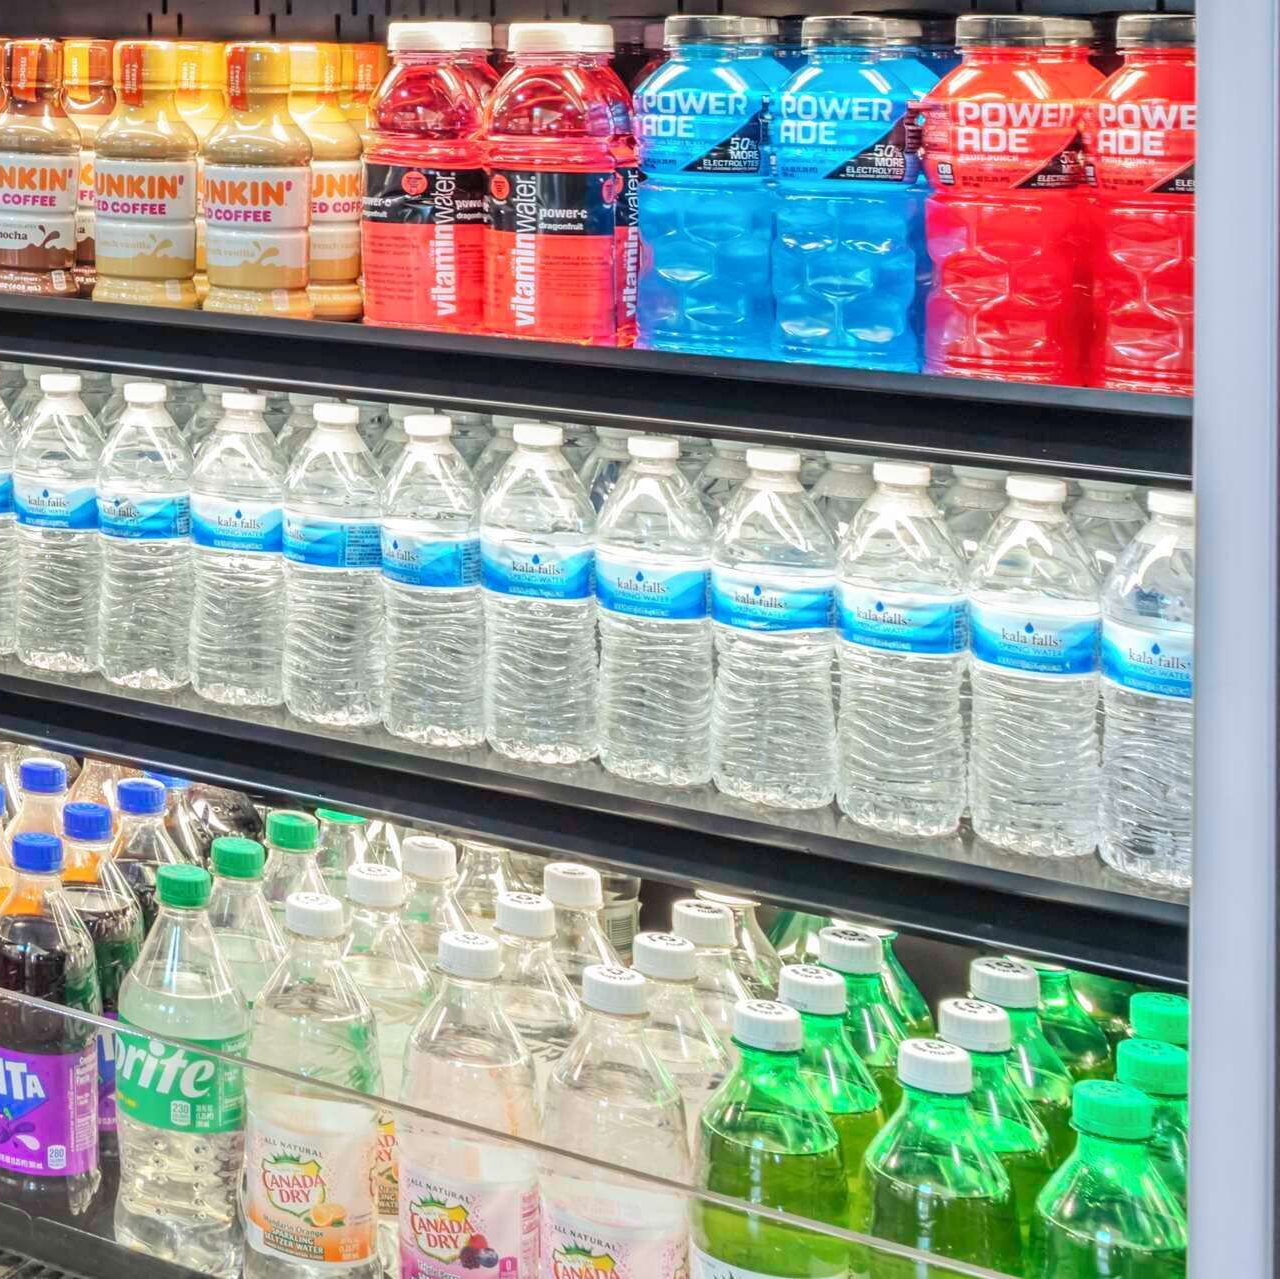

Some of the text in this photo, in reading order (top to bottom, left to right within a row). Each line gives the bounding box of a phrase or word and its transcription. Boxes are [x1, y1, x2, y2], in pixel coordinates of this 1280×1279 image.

[642, 91, 747, 116] POWER
[779, 94, 892, 121] POWER
[957, 101, 1074, 128] POWER
[1098, 102, 1196, 131] POWE
[642, 115, 696, 138] ADE
[779, 121, 837, 145] ADE
[957, 127, 1031, 153] ADE
[1097, 129, 1165, 156] ADE
[730, 150, 760, 160] MORE
[873, 144, 904, 159] 50%
[702, 159, 760, 169] ELECTROLYTES
[874, 157, 905, 168] MORE
[845, 167, 905, 176] ELECTROLYTES
[95, 171, 184, 200] UNKIN'
[204, 176, 293, 207] UNKIN'
[2, 193, 57, 207] COFFEE
[110, 200, 167, 216] COFFEE
[215, 208, 272, 224] COFFEE
[539, 207, 588, 220] power-c
[539, 221, 584, 233] dragonfruit
[429, 170, 458, 317] vitaminwater.
[506, 173, 538, 327] vitaminwater.
[217, 515, 262, 530] kala falls
[511, 560, 563, 576] kala falls
[617, 576, 668, 594] kala falls
[734, 593, 786, 610] kala falls
[856, 607, 910, 627] kala falls
[1001, 627, 1061, 648] kala falls
[1034, 645, 1063, 657] WATER
[1128, 647, 1189, 670] kala falls
[116, 1024, 216, 1099] rite
[172, 1103, 190, 1114] 230
[49, 1148, 65, 1159] 280
[281, 1141, 323, 1158] NATURAL
[262, 1169, 327, 1193] CANADA
[279, 1187, 313, 1204] DRY
[410, 1178, 472, 1204] ALL NATURAL
[295, 1223, 325, 1238] Orange
[410, 1212, 476, 1235] CANADA
[296, 1242, 325, 1254] WATER
[425, 1232, 461, 1249] DRY
[570, 1228, 618, 1251] NATURAL
